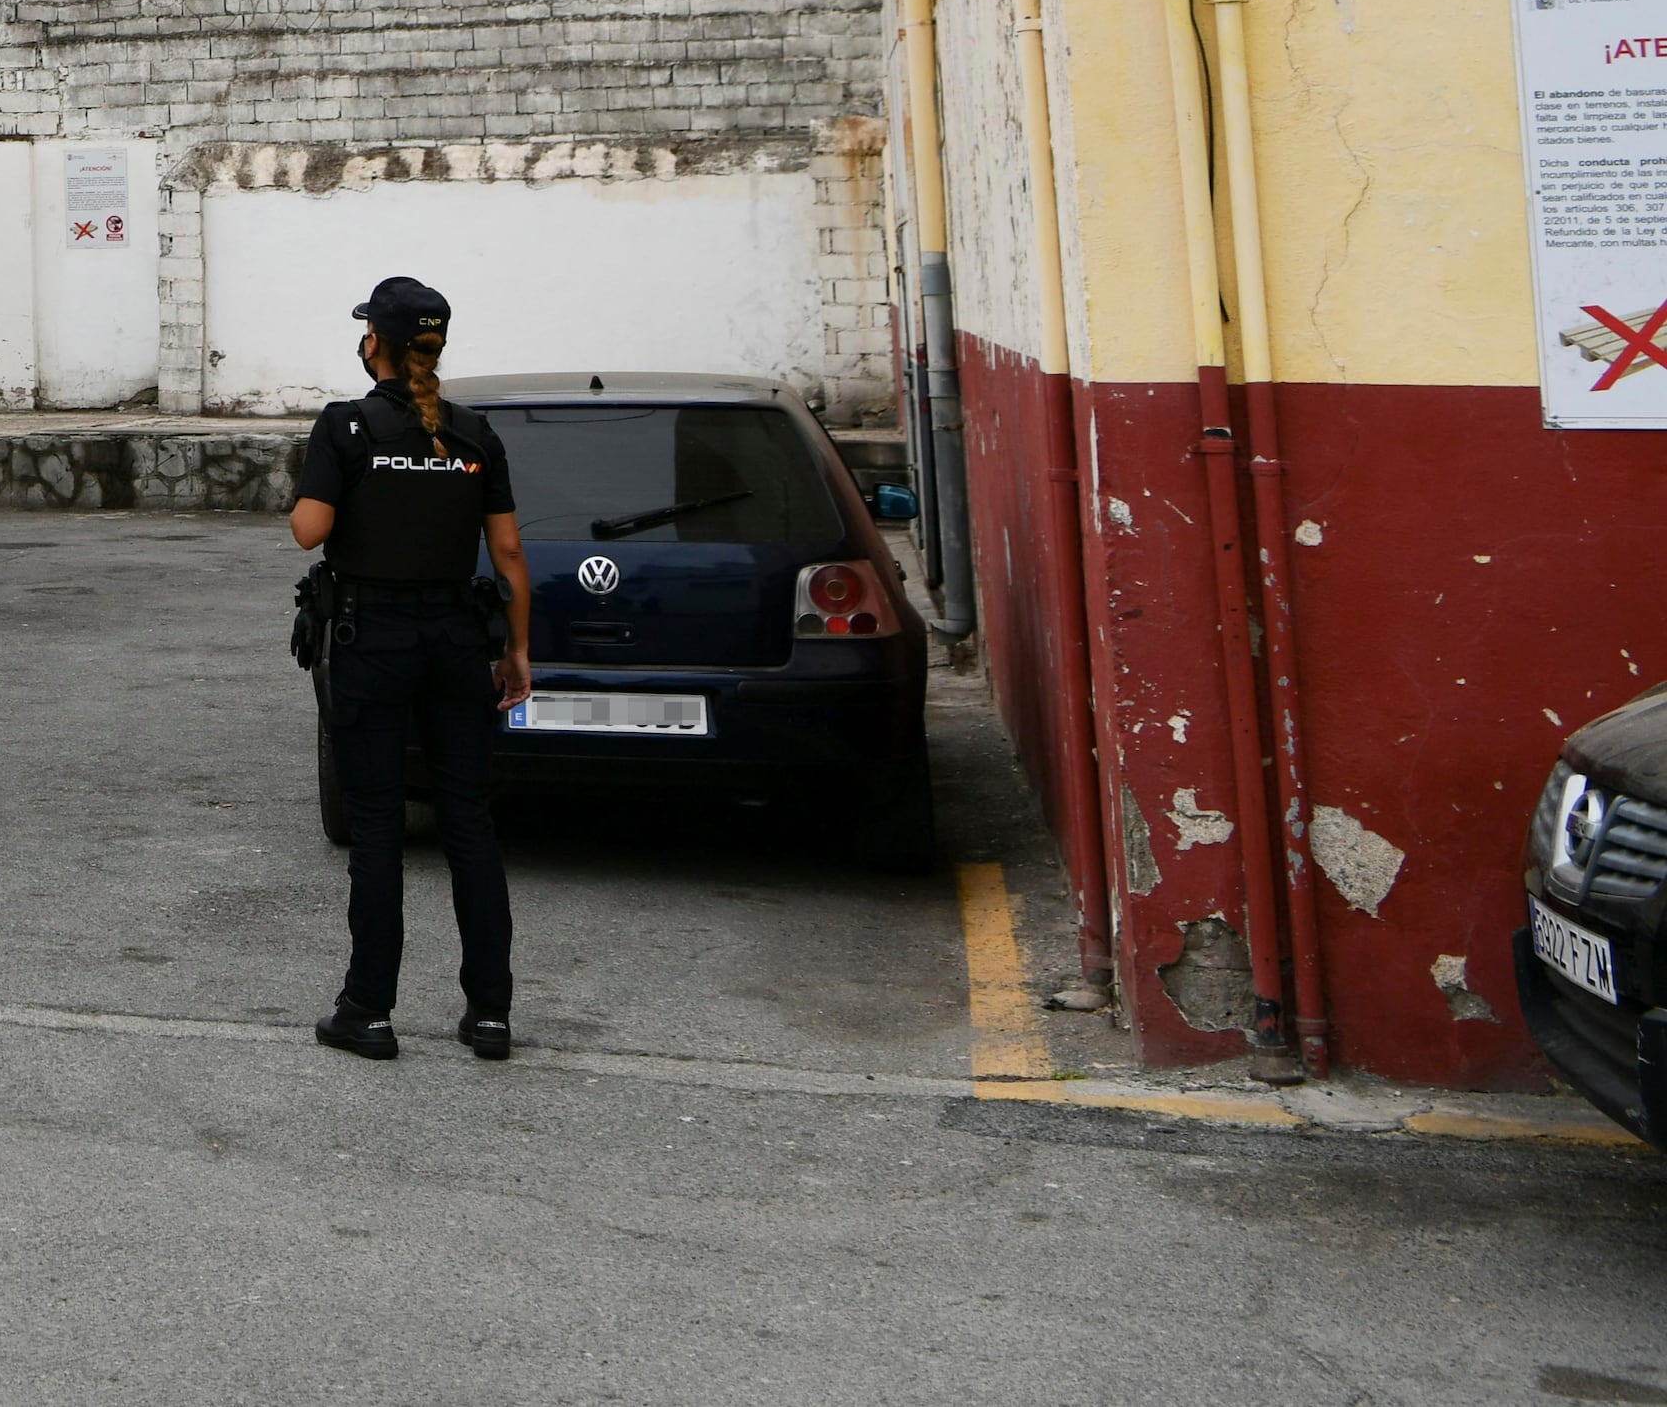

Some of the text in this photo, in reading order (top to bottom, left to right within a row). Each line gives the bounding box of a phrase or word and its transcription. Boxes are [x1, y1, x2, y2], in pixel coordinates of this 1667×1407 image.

[1534, 90, 1545, 99] El
[1549, 89, 1605, 98] abandono
[1608, 88, 1621, 97] de
[1535, 102, 1562, 110] clase
[1567, 101, 1580, 110] en
[1585, 100, 1631, 109] terrenos,
[1535, 110, 1667, 122] falta de limpieza de las
[1600, 124, 1607, 132] o
[1611, 123, 1658, 132] cualquier
[1537, 135, 1614, 145] citados bienes.
[1539, 159, 1569, 168] Dicha
[1578, 158, 1630, 167] conducta
[1540, 169, 1617, 180] incumplimiento
[1621, 168, 1634, 177] de
[1638, 168, 1652, 177] las
[1541, 181, 1556, 191] sin
[1561, 181, 1605, 192] perjuicio
[1610, 180, 1624, 189] de
[1629, 181, 1649, 190] que
[1542, 194, 1567, 202] sean
[1570, 192, 1625, 201] calificados
[1628, 192, 1642, 200] en
[1543, 204, 1558, 214] los
[1645, 202, 1664, 212] 307
[1587, 215, 1600, 224] de
[1605, 215, 1612, 224] 5
[1616, 215, 1630, 224] de
[1545, 227, 1598, 237] Refundido
[1603, 227, 1617, 236] de
[1621, 226, 1631, 235] la
[1636, 226, 1656, 237] Ley
[1600, 239, 1619, 247] con
[1622, 238, 1657, 247] multas
[419, 317, 442, 326] CNP
